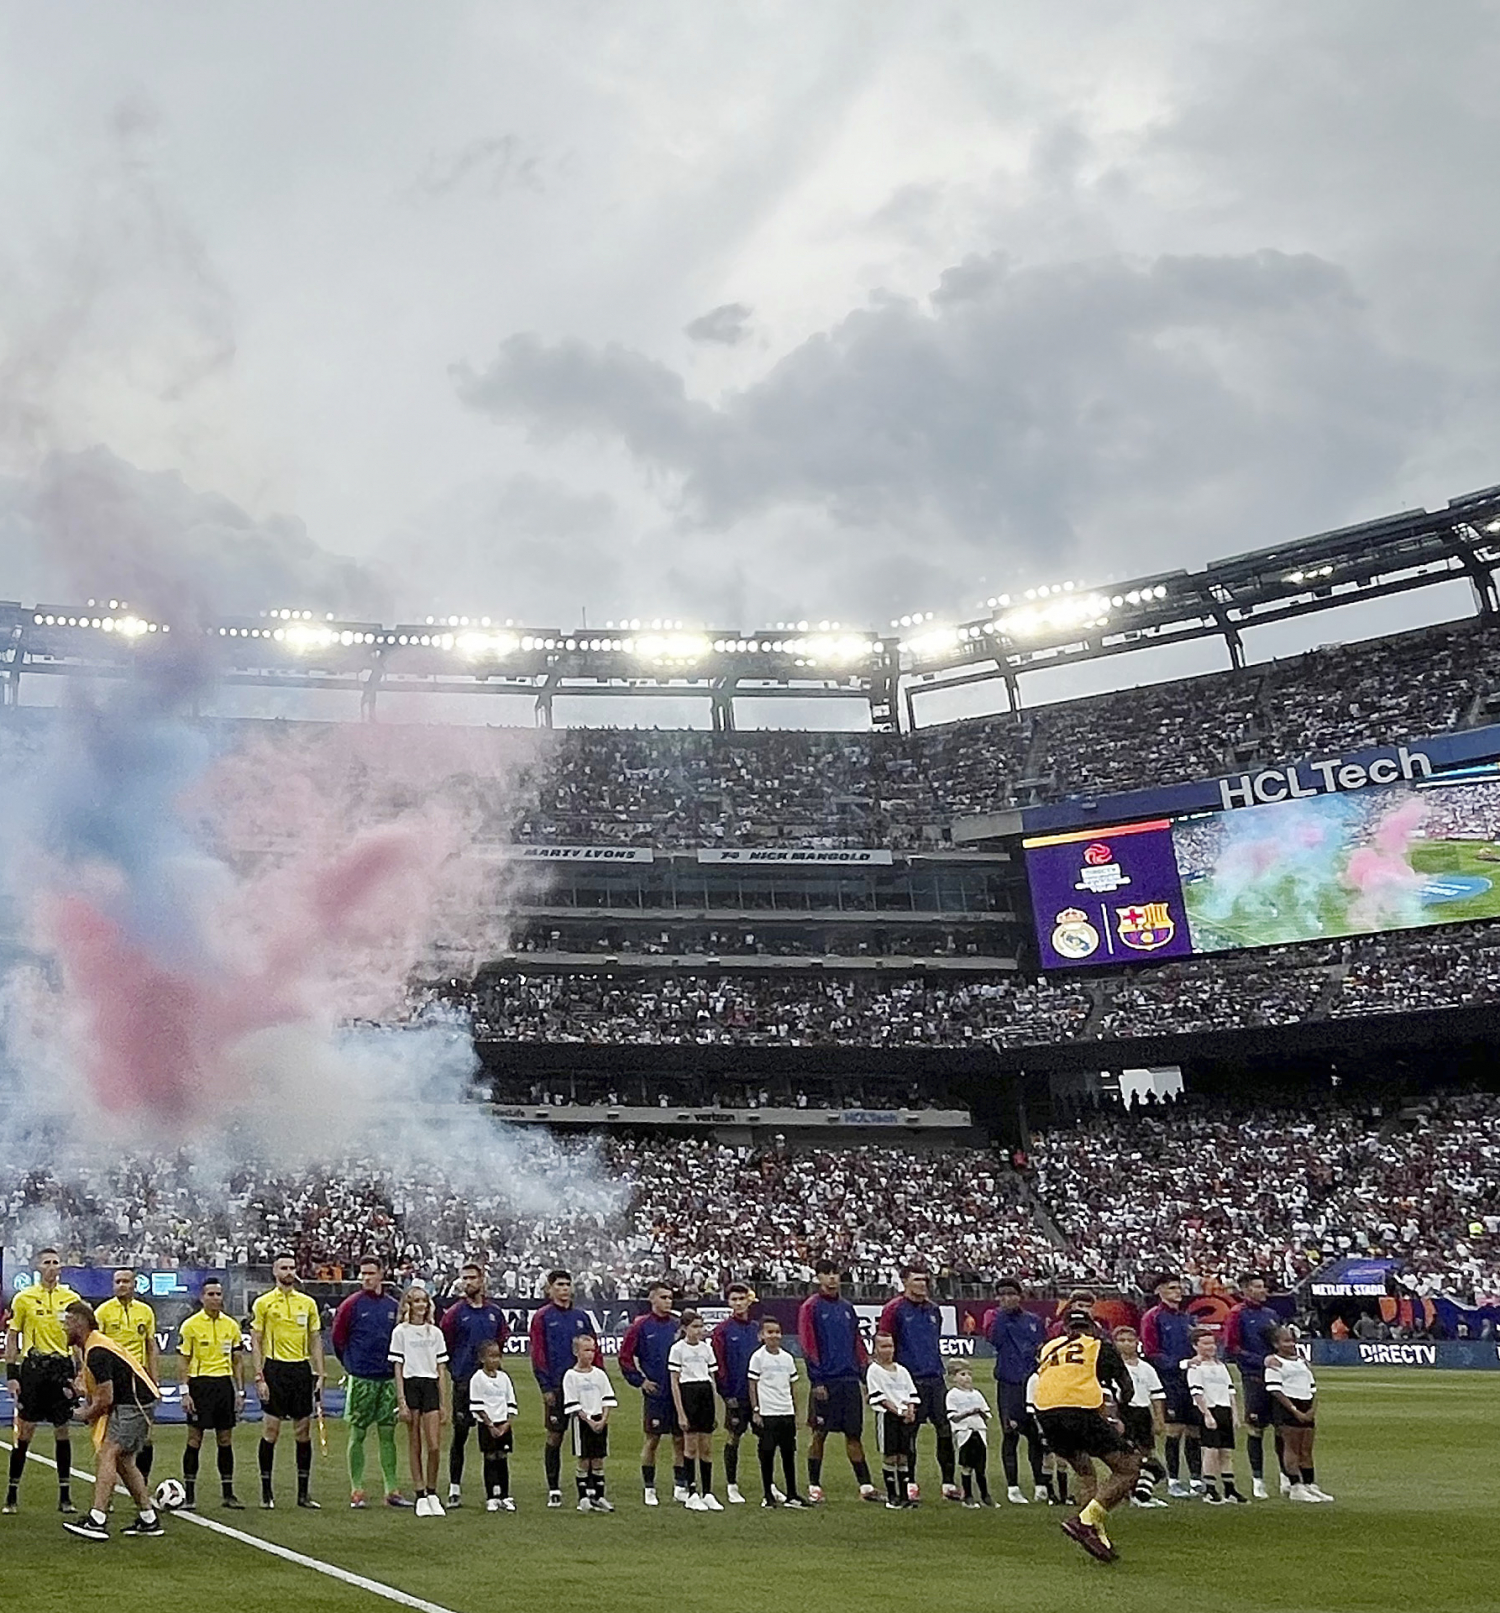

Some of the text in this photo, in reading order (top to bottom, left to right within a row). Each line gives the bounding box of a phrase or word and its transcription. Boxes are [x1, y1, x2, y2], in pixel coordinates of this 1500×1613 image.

[1219, 746, 1432, 810] HCLTech
[523, 848, 636, 859] MARTY LYONS
[749, 851, 788, 860] NICK
[790, 852, 871, 861] MANGOLD
[1359, 1343, 1436, 1365] DIRECTV
